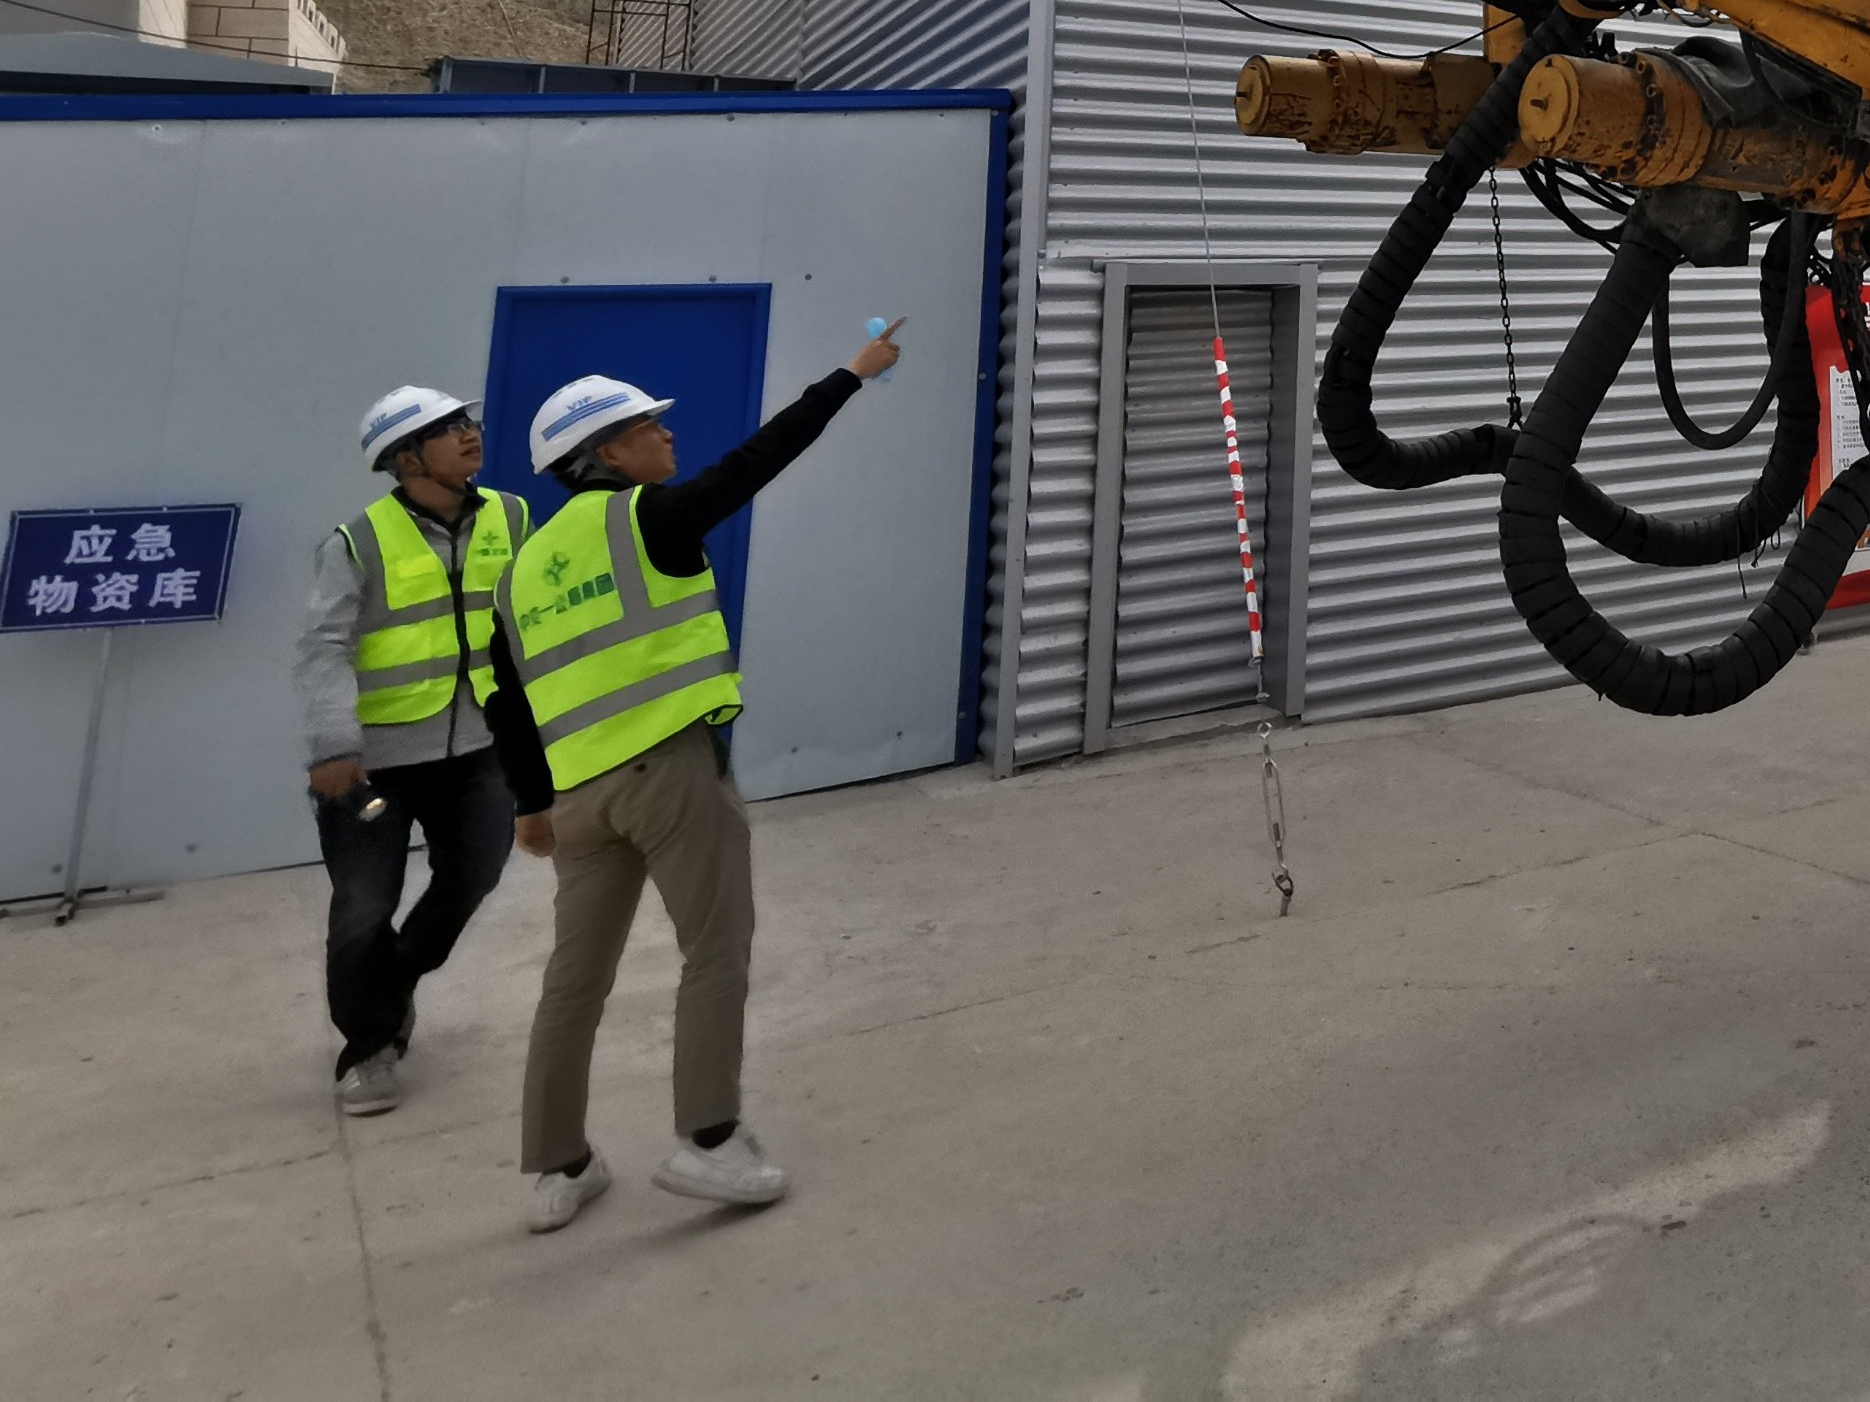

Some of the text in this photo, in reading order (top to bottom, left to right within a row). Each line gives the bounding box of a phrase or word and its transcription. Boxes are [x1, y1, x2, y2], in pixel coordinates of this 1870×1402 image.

[566, 395, 593, 411] VIP
[63, 522, 176, 565] 应急
[26, 567, 201, 617] 物资库
